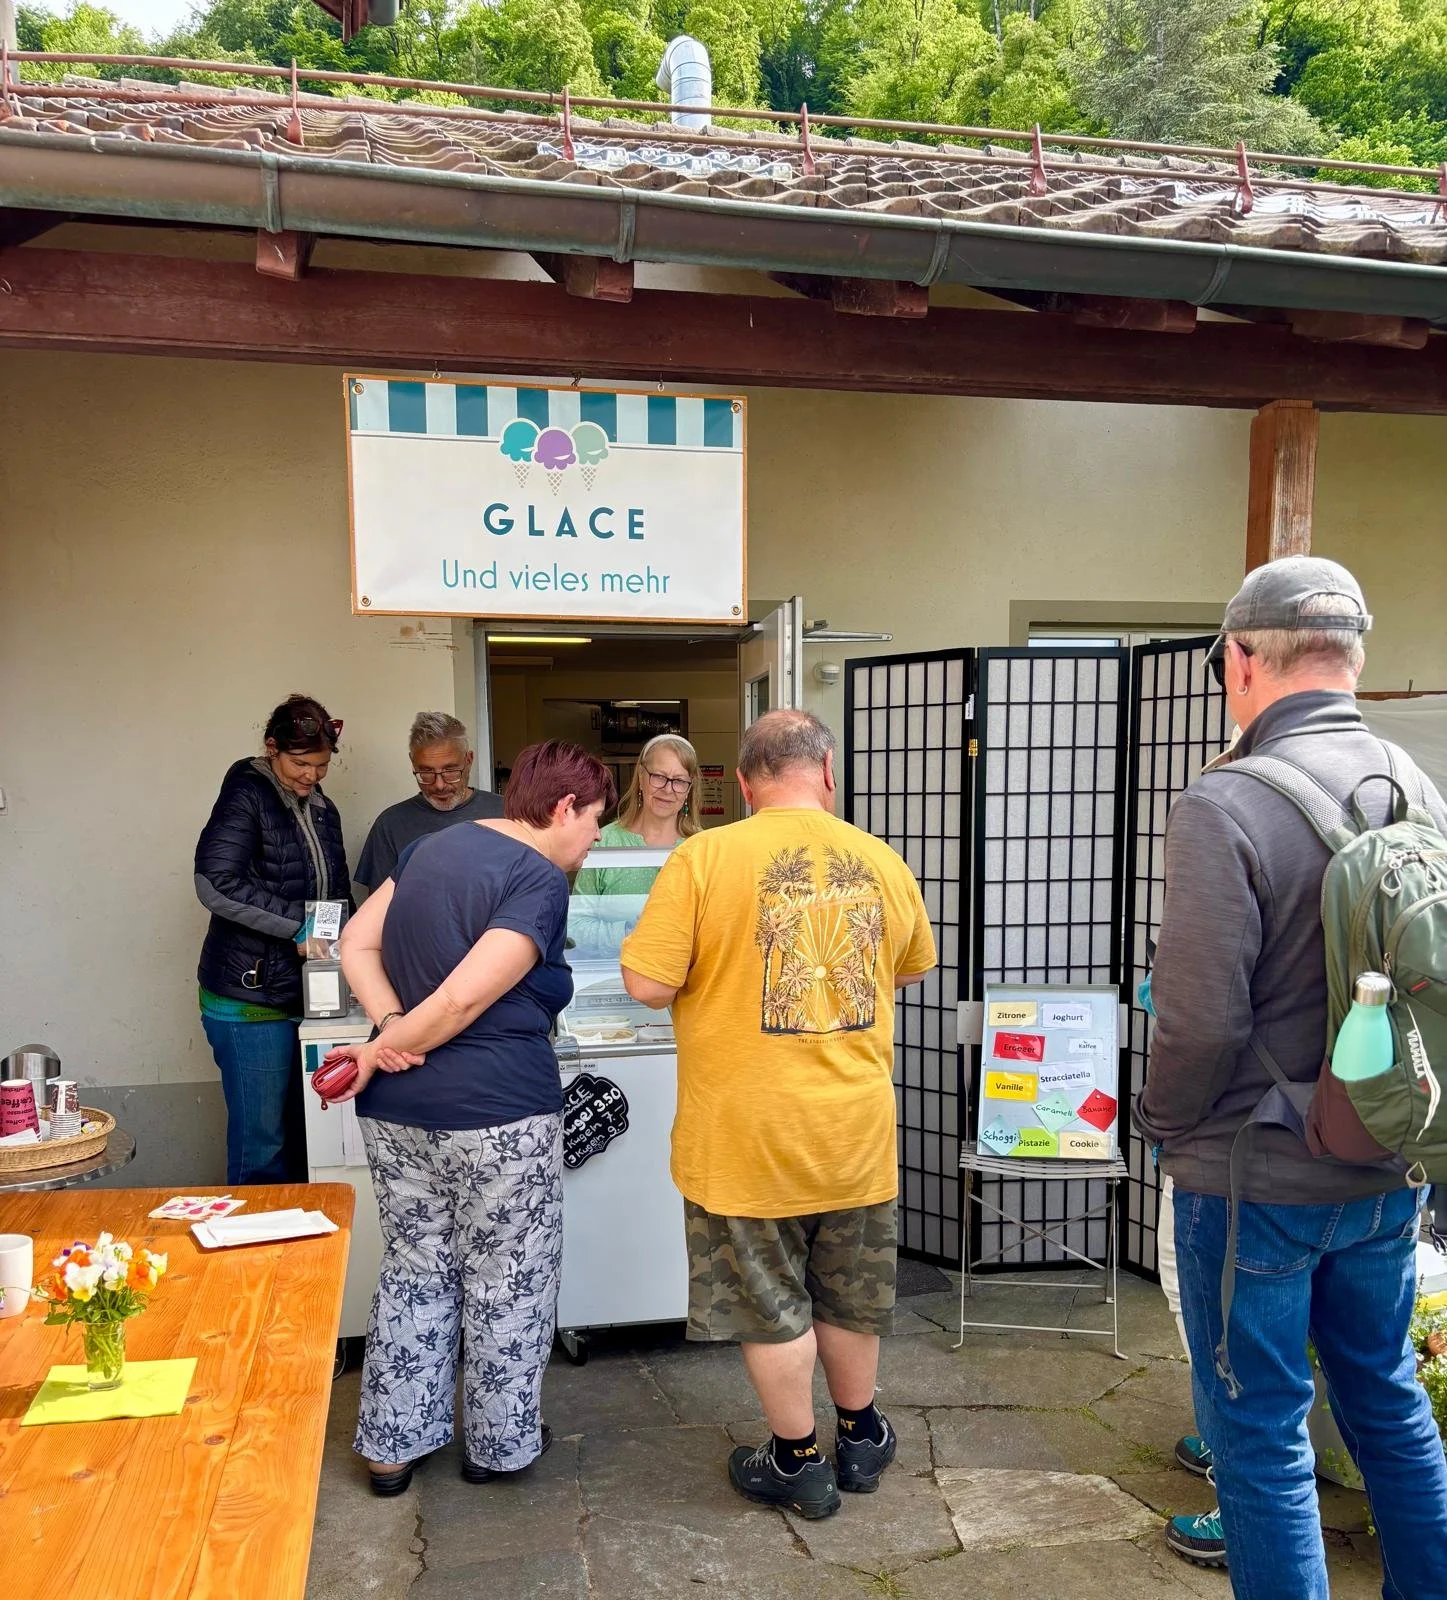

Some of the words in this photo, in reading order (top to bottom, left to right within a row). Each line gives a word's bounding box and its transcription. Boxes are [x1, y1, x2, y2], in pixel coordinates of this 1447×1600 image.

[483, 502, 645, 540] GLACE
[442, 559, 497, 589] Und
[509, 562, 589, 592] vieles
[601, 565, 670, 594] mehr
[997, 1011, 1027, 1019] Zitrone
[1052, 1013, 1084, 1025] Joghurt
[1406, 1029, 1426, 1079] VIAMALA
[1040, 1071, 1091, 1083] Stracciatella
[995, 1082, 1024, 1092] Vanille
[594, 1087, 621, 1112] 3.50
[1035, 1104, 1073, 1117] Caramell
[566, 1122, 603, 1149] Kugeln
[983, 1130, 1017, 1144] Schoggi
[568, 1154, 577, 1164] 3
[575, 1134, 605, 1158] Kugeln
[1018, 1139, 1051, 1147] Pistazie
[1069, 1139, 1100, 1148] Cookie
